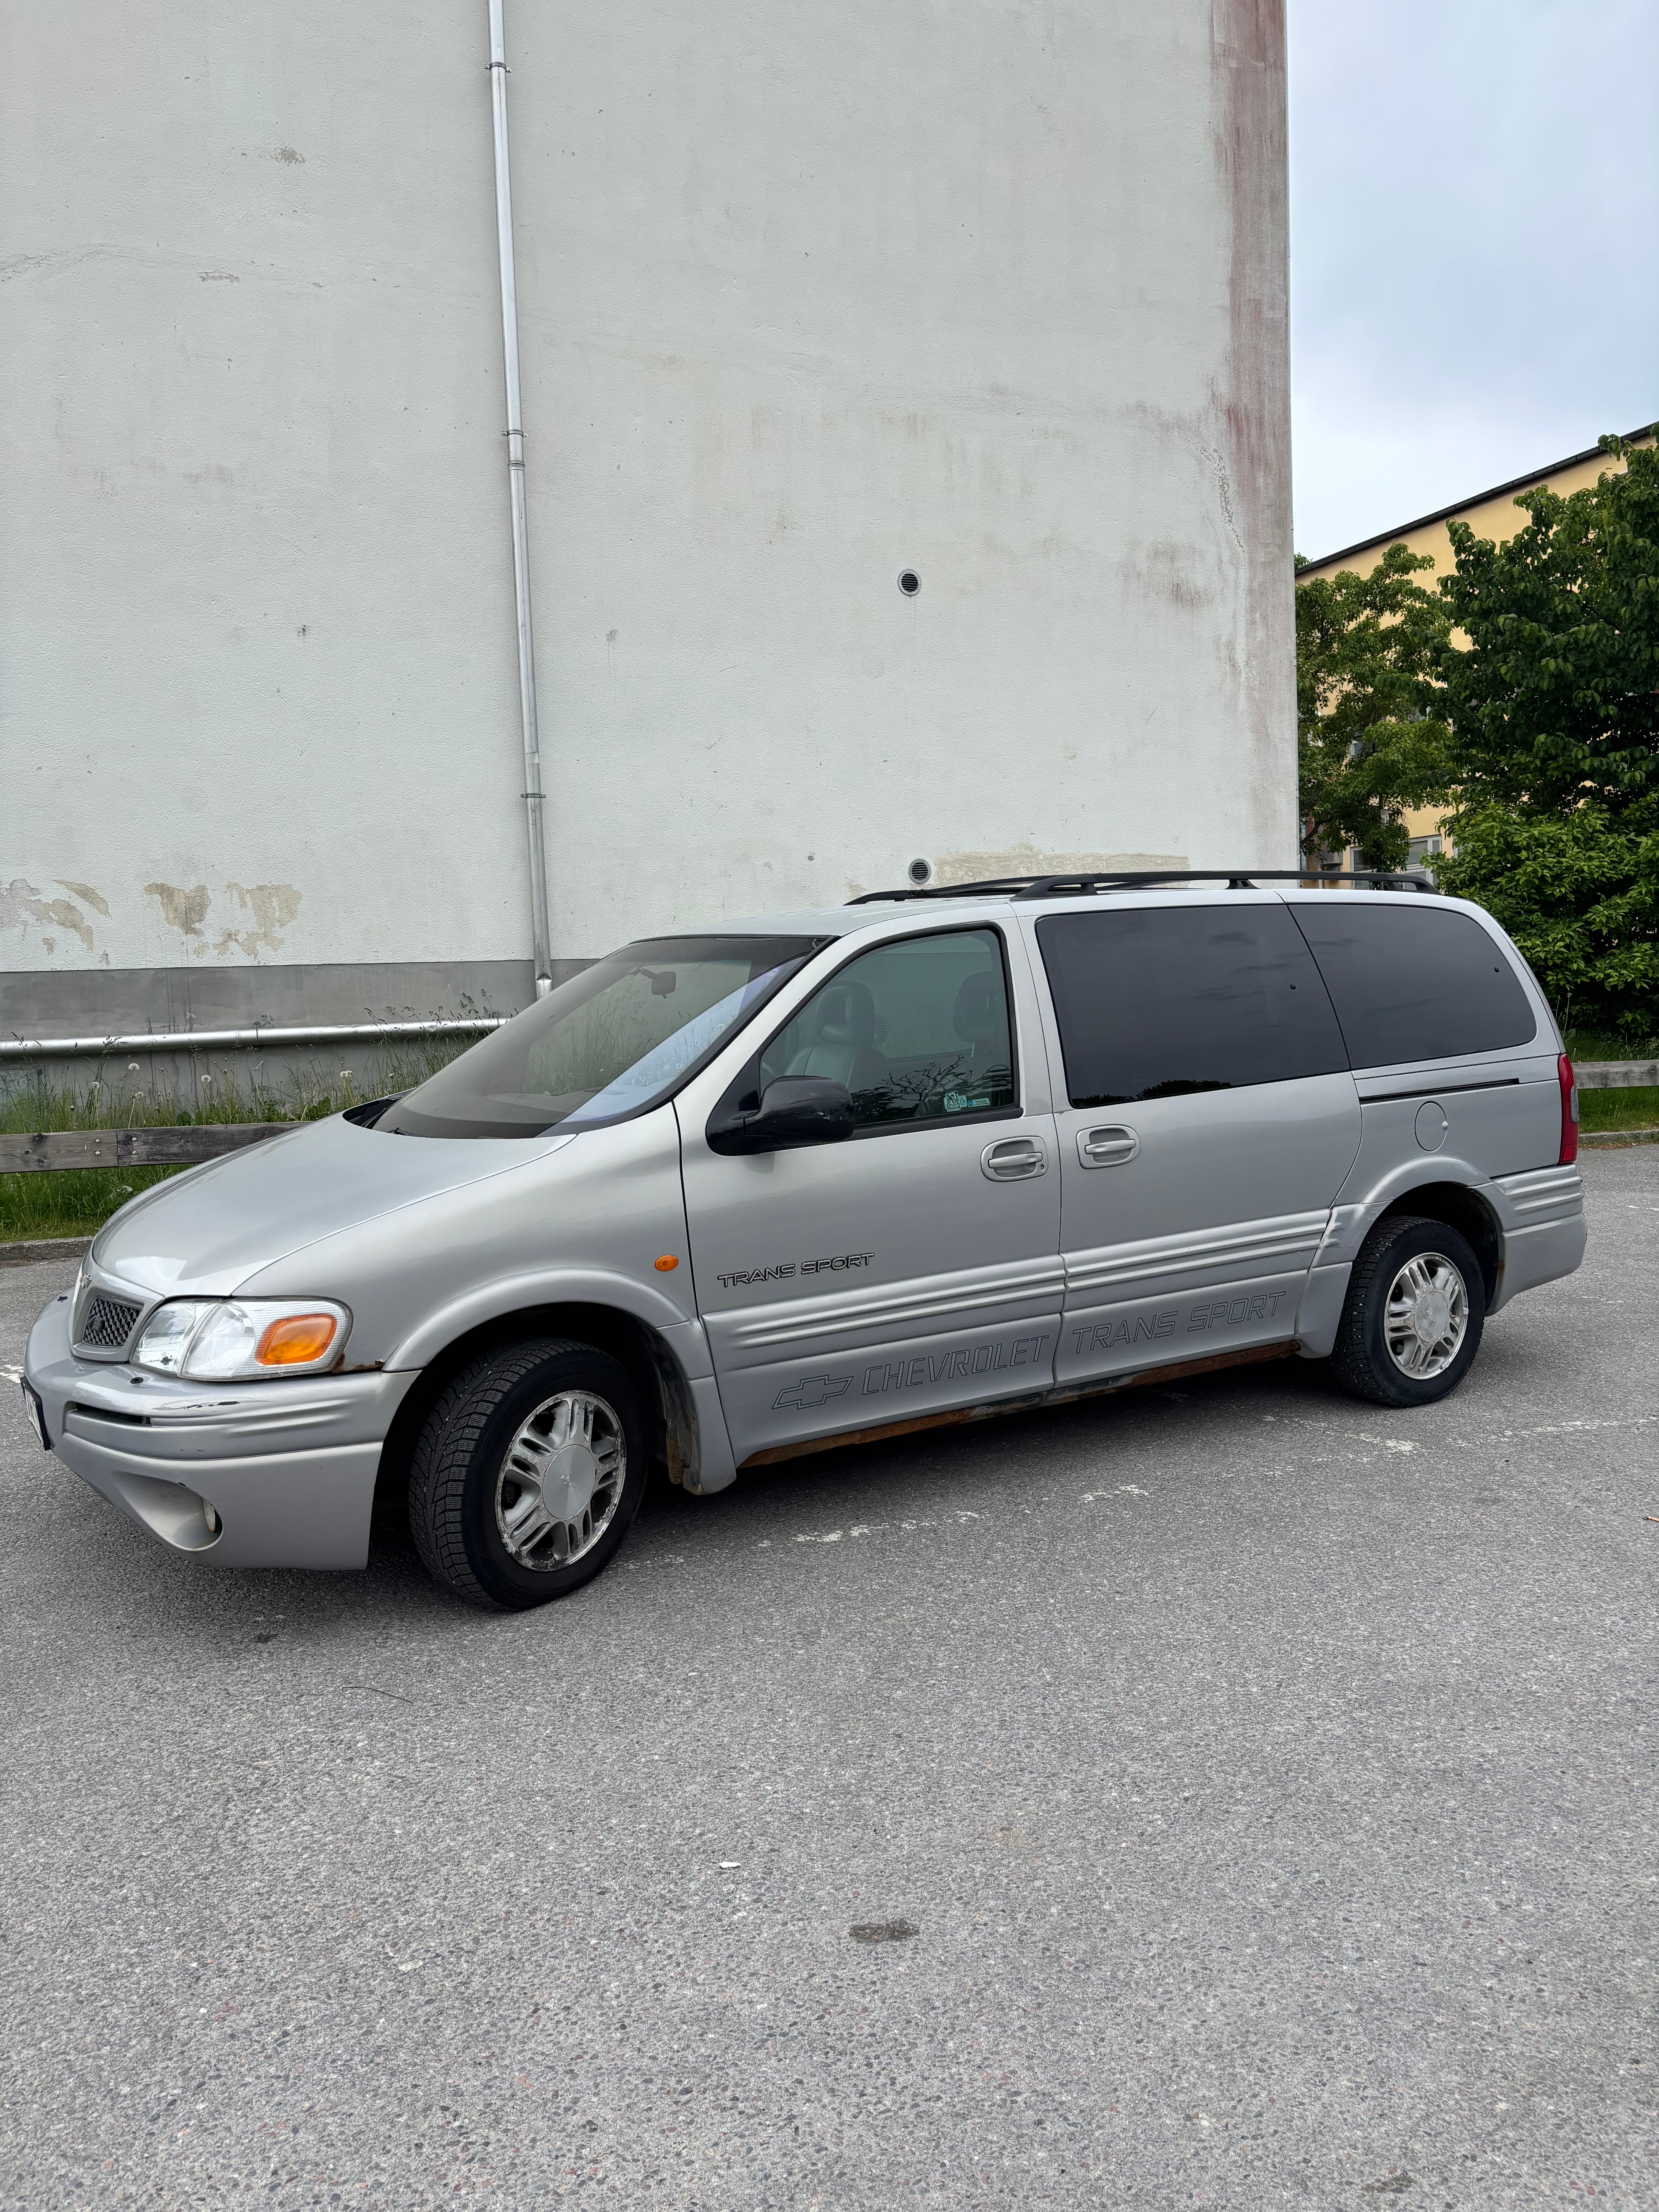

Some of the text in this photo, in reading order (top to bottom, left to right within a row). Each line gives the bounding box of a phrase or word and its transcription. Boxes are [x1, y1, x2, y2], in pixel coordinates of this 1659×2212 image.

[718, 1252, 874, 1287] TRANS SPORT
[862, 1291, 1286, 1395] CHEVROLET TRANS SPORT
